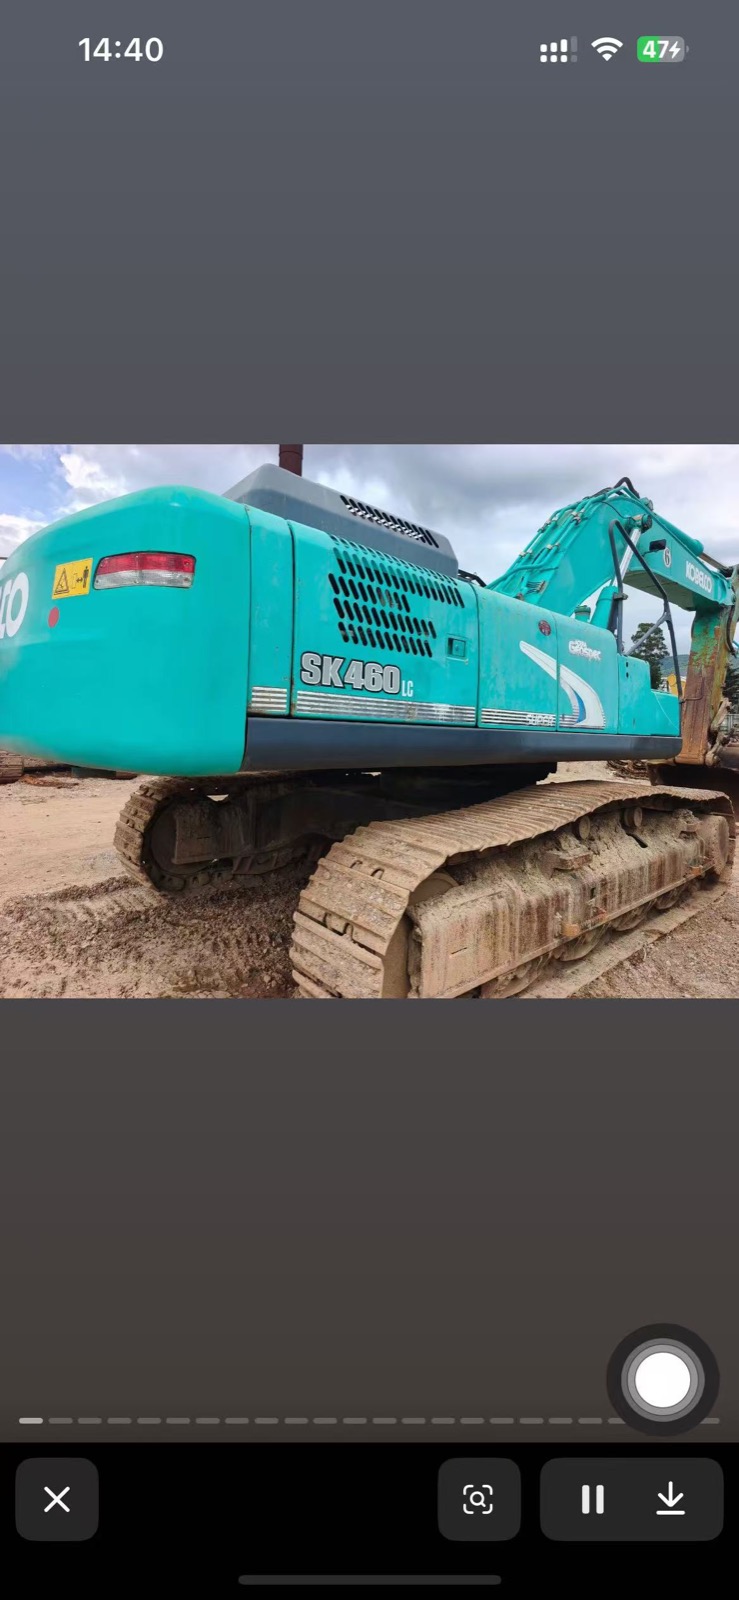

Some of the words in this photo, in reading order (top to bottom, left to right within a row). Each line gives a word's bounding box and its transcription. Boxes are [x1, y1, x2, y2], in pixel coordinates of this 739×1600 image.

[685, 560, 713, 593] KOBELCO
[0, 572, 29, 639] CO
[299, 650, 402, 696] SK460
[401, 680, 414, 698] LC
